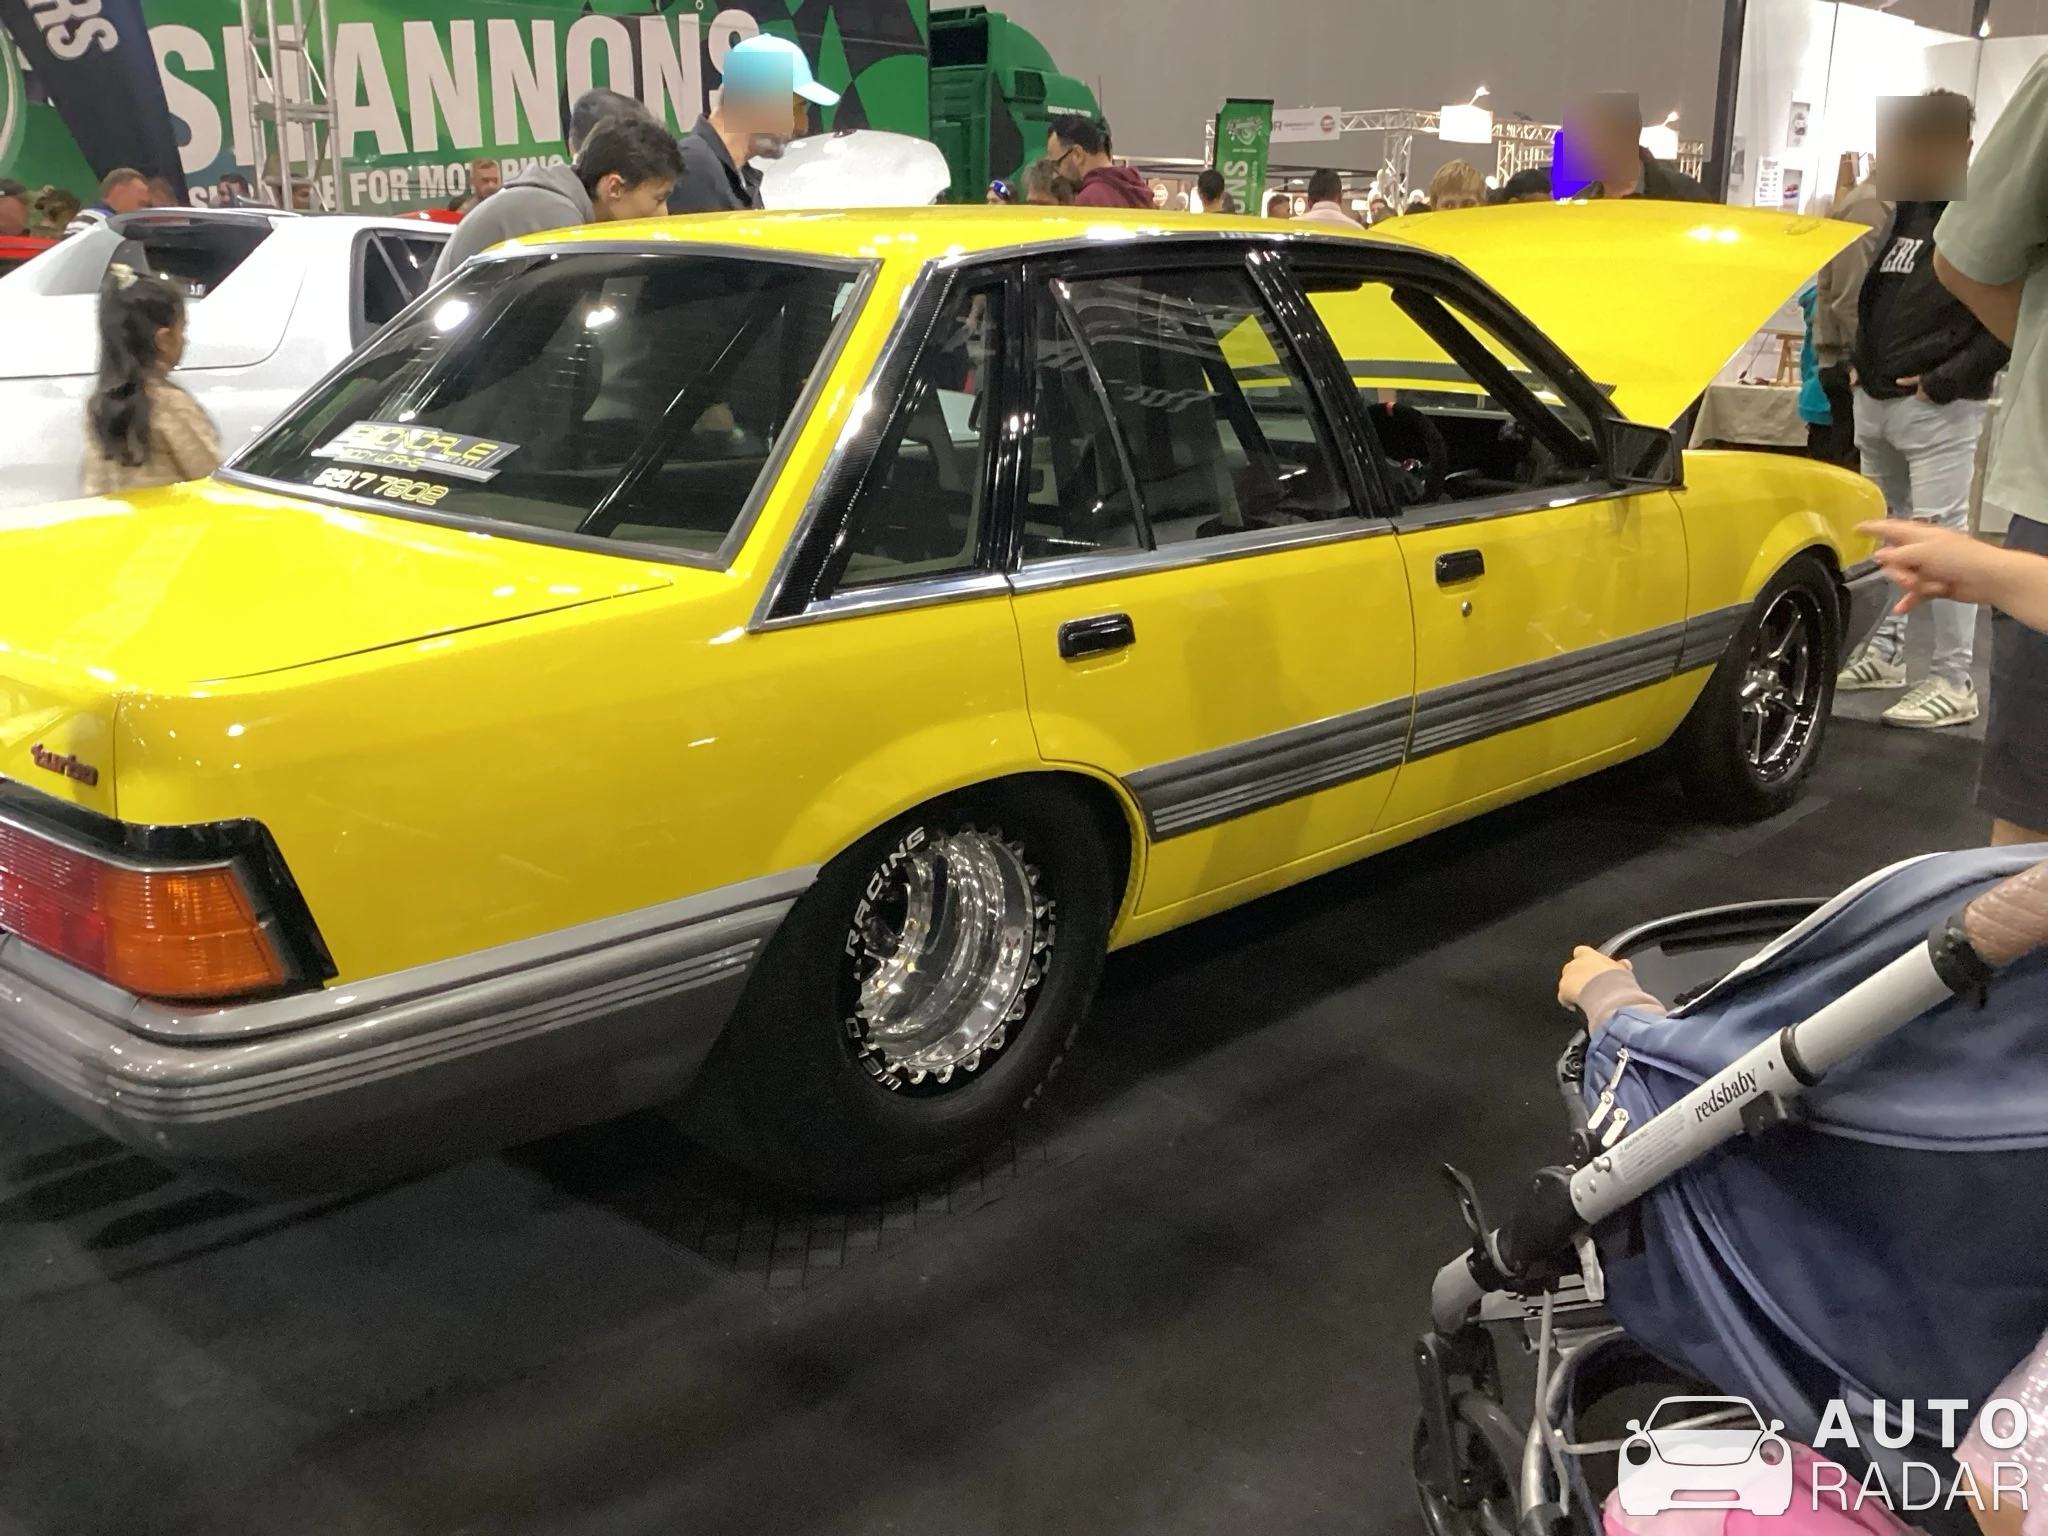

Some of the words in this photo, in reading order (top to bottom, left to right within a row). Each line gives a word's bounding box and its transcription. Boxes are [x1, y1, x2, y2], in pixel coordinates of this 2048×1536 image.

[349, 168, 410, 206] FOR
[845, 826, 925, 957] RACING
[1694, 1067, 1758, 1123] redsbaby
